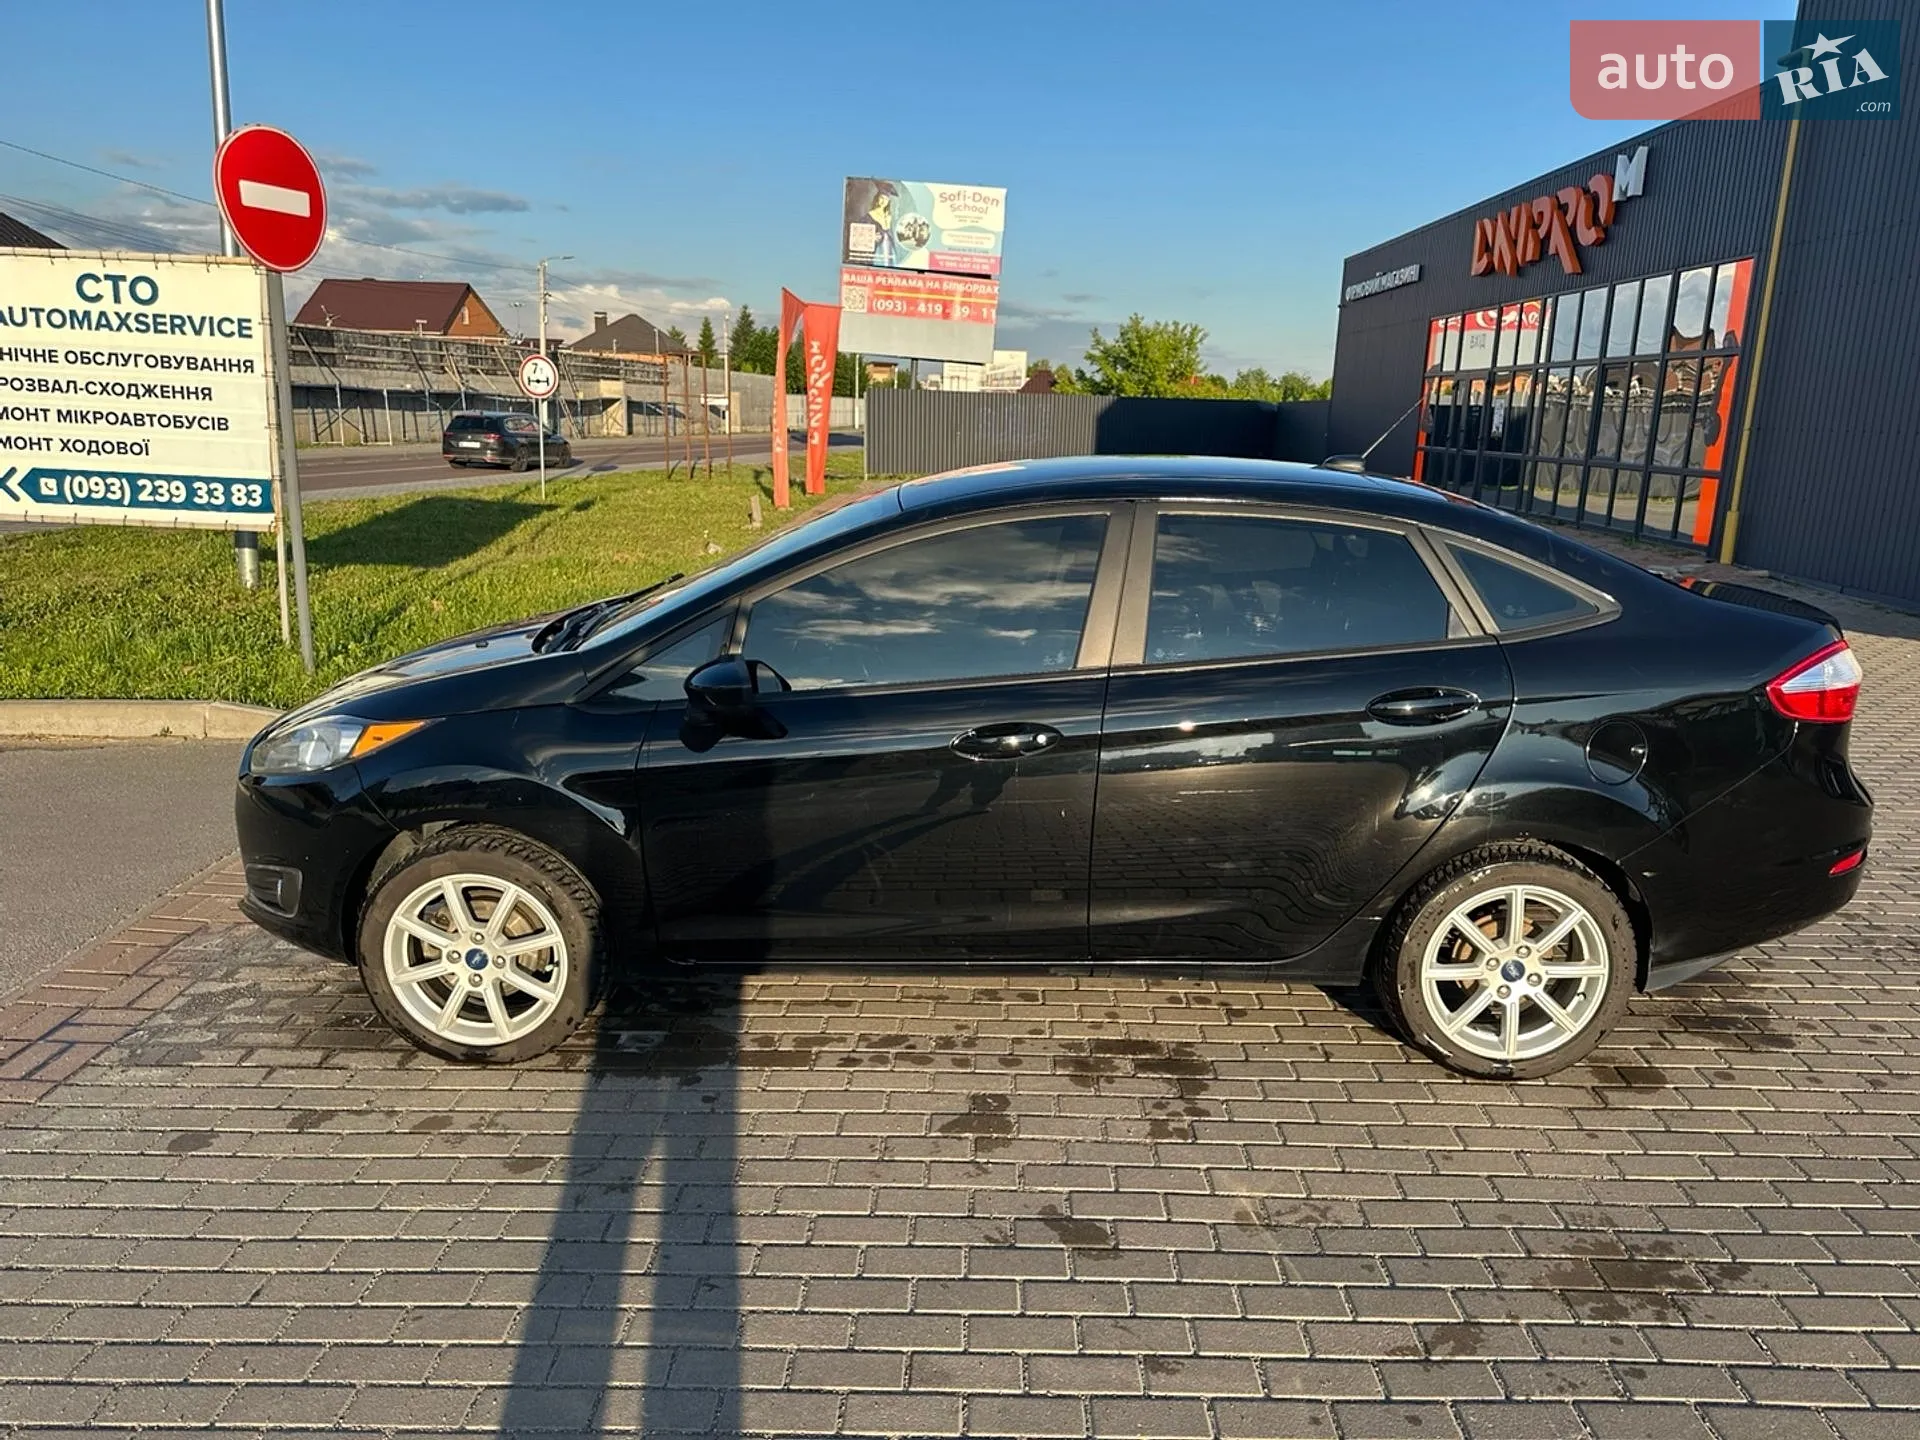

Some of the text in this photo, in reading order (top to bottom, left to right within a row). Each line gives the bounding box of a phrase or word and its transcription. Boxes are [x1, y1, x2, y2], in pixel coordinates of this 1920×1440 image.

[939, 190, 1000, 208] Sofi-Den
[949, 203, 988, 215] School
[76, 272, 159, 306] СТО
[875, 277, 923, 288] РЕКЛАМА
[926, 280, 940, 290] НА
[872, 298, 907, 314] (093)
[918, 302, 942, 315] 419
[64, 350, 254, 374] ОБСЛУГОВУВАННЯ
[0, 376, 212, 401] РОЗВАЛ-СХОДЖЕННЯ
[56, 408, 230, 431] МІКРОАВТОБУСІВ
[60, 438, 150, 457] ХОДОВОЇ
[63, 474, 263, 507] (093) 239 33 83
